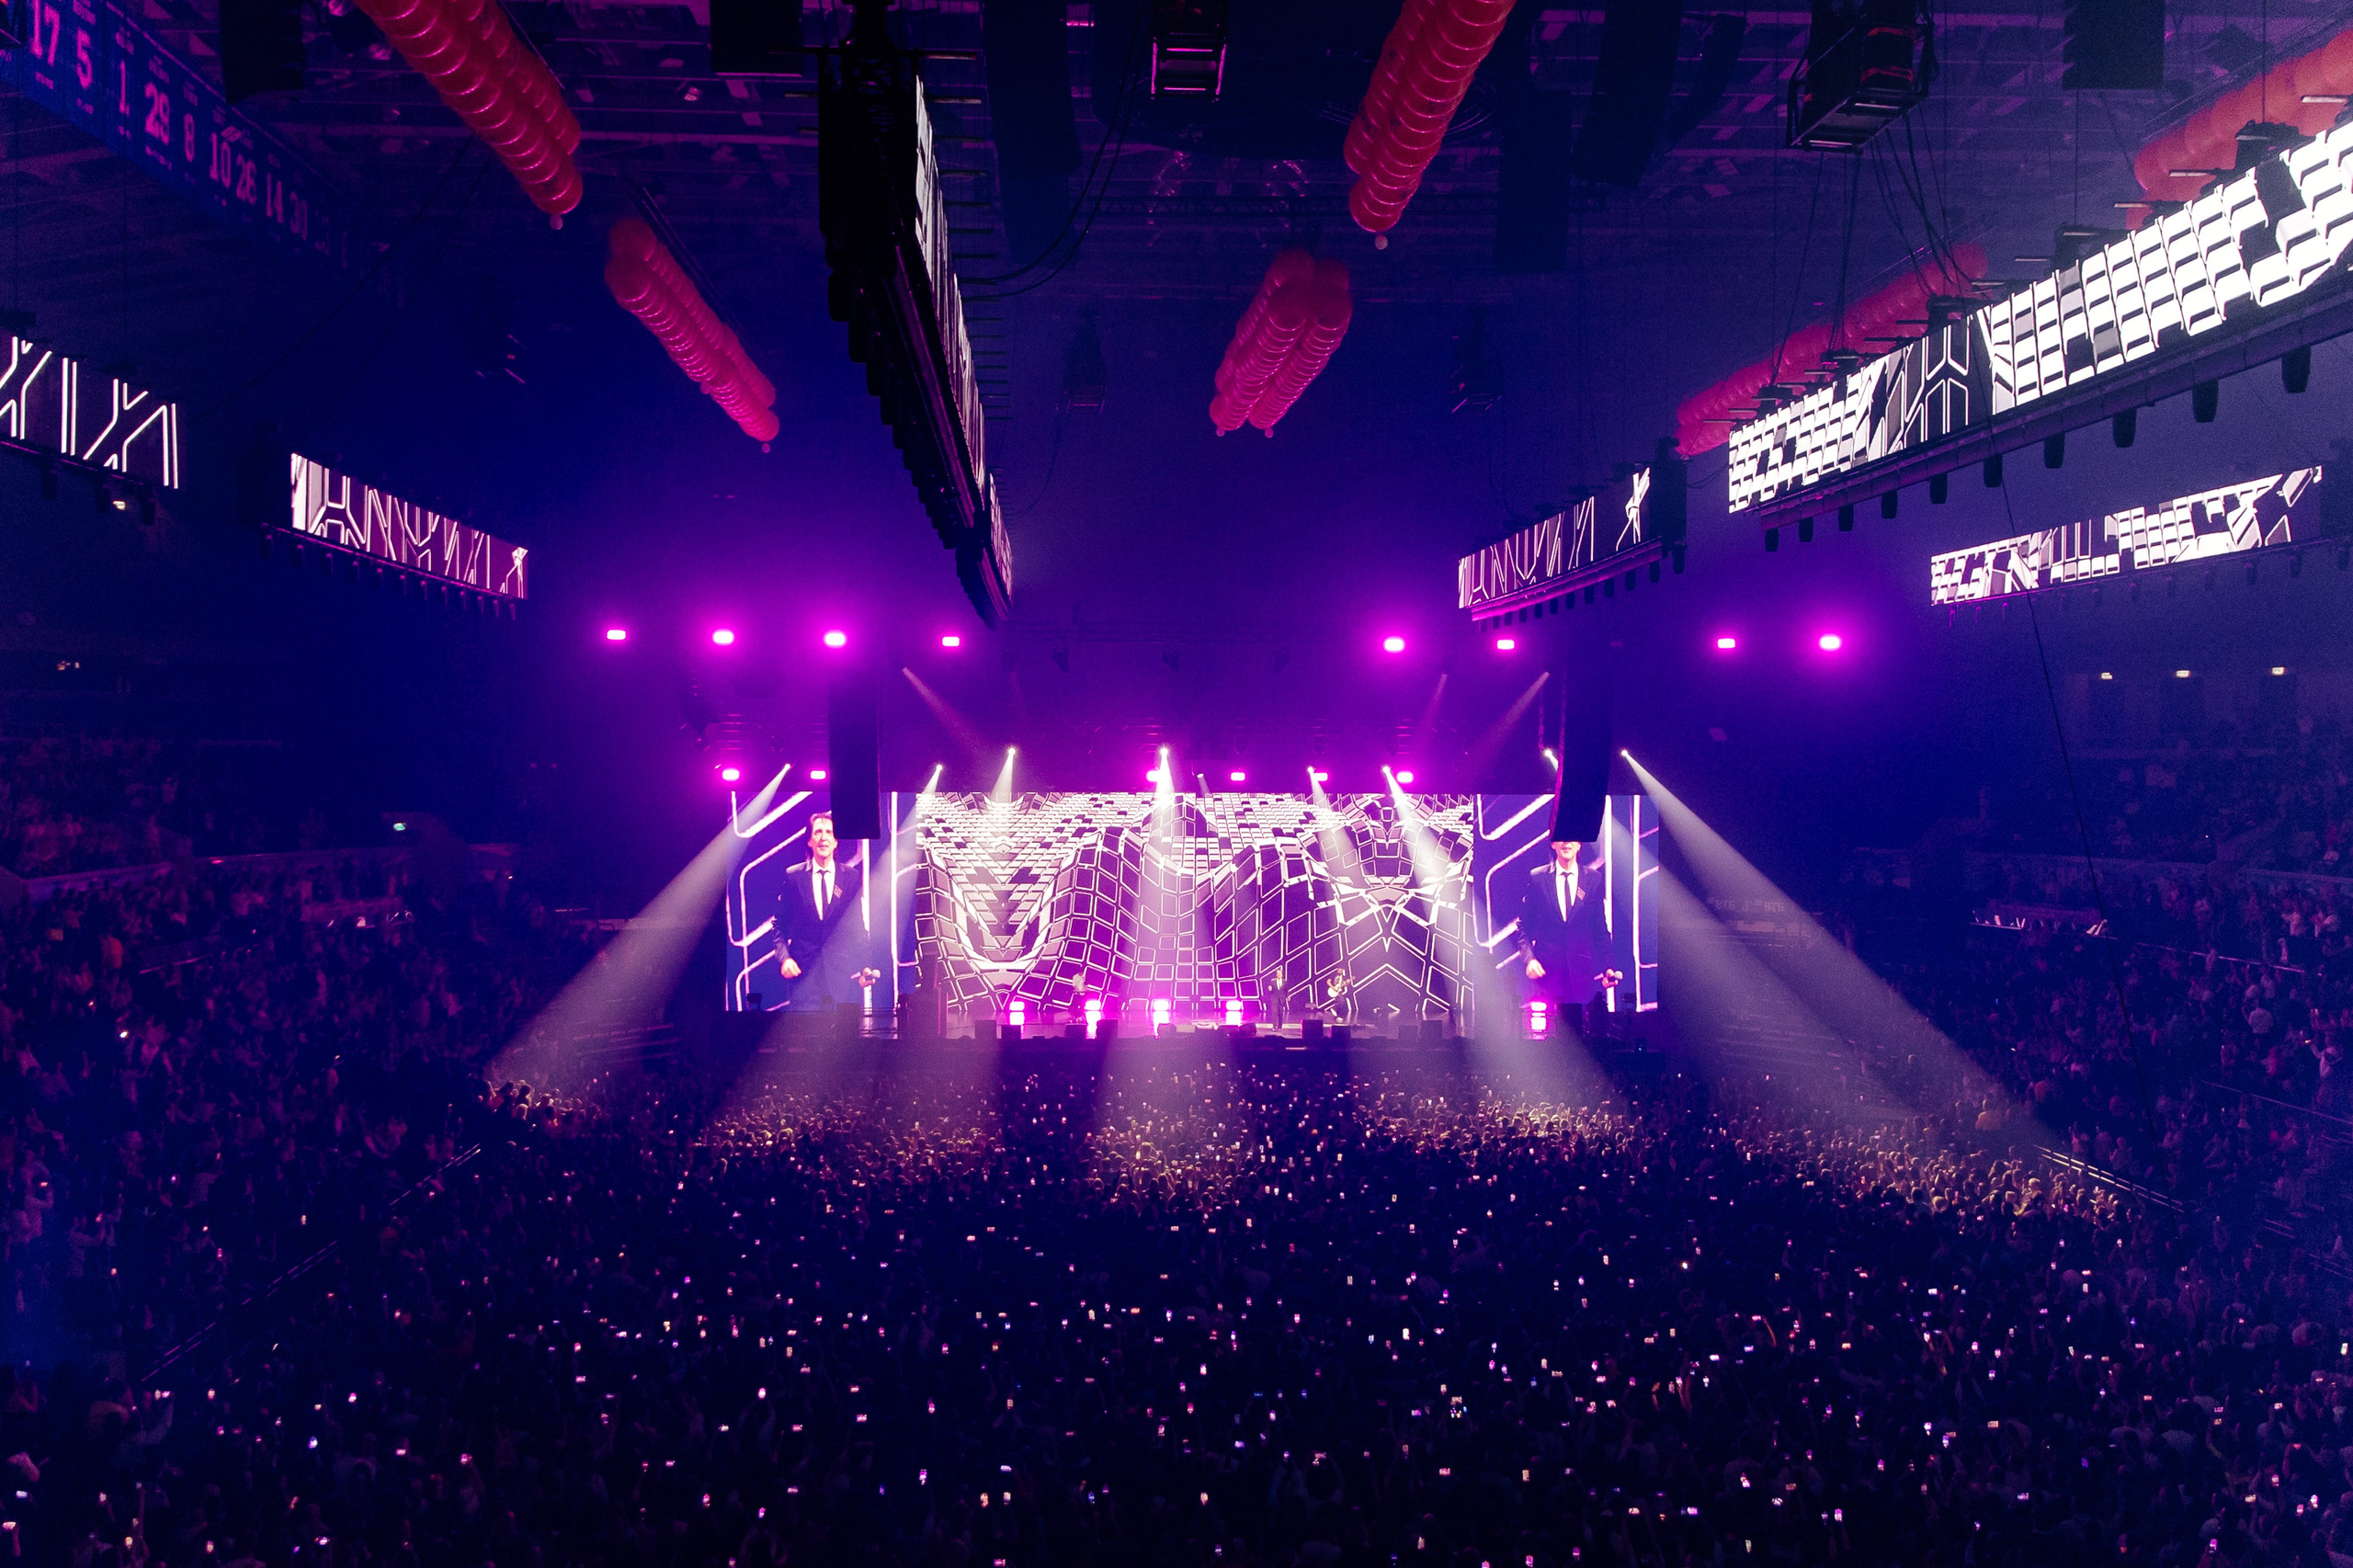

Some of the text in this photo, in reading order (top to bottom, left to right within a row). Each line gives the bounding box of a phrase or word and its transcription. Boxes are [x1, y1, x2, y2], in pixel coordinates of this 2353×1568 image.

[29, 0, 61, 67] 17
[76, 28, 93, 90] 5
[145, 82, 171, 145] 29
[210, 131, 233, 188] 10
[235, 154, 258, 206] 26
